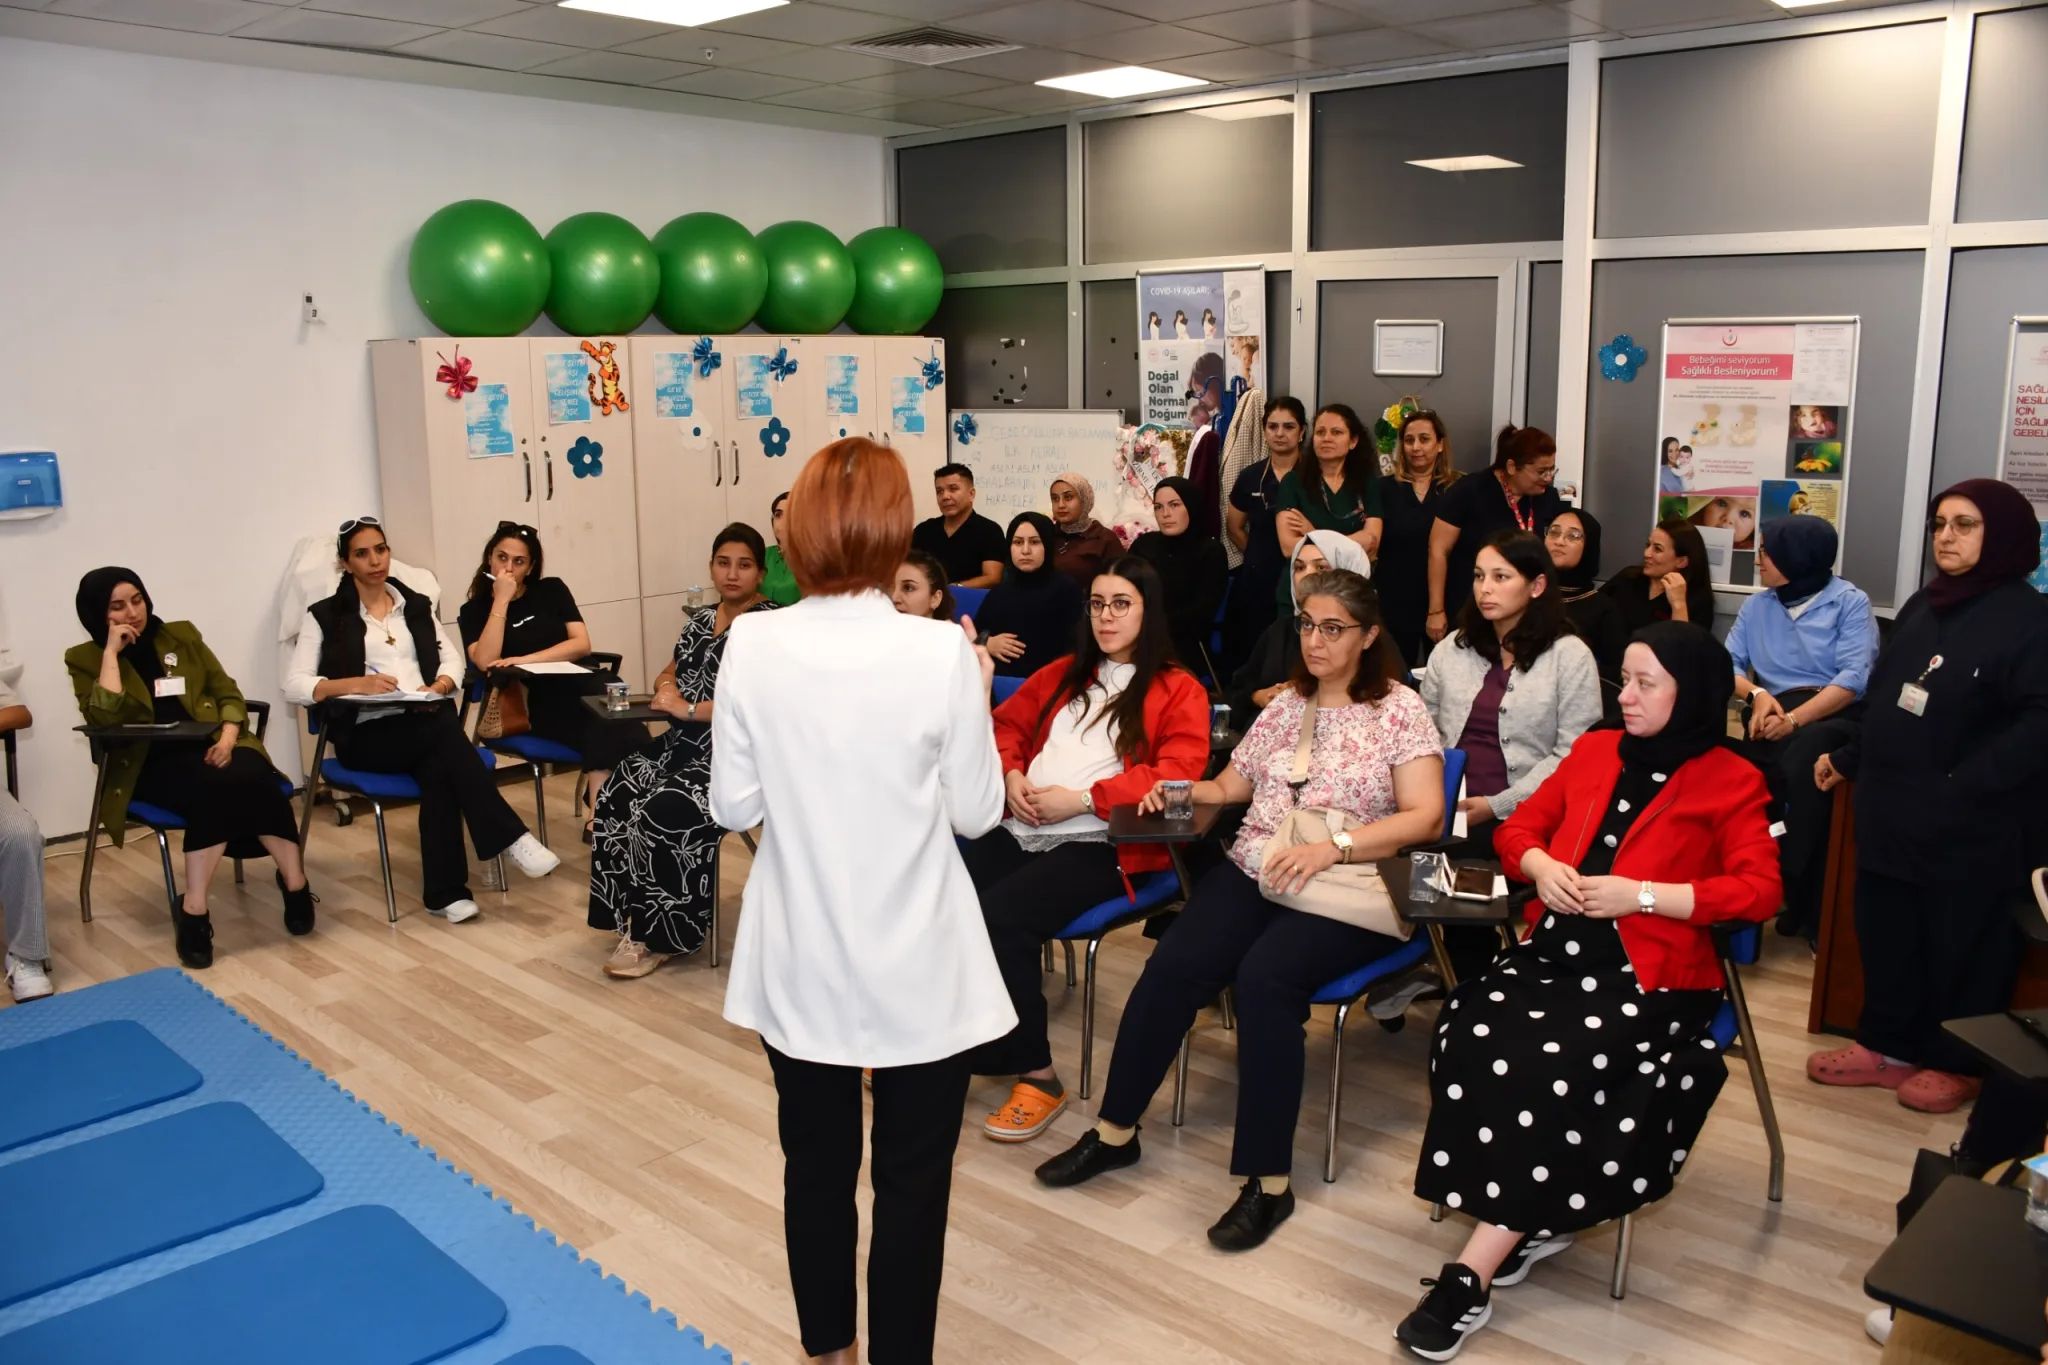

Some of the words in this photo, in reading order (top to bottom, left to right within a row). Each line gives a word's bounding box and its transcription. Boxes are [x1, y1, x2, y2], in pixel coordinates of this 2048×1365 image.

[1150, 287, 1181, 297] COVID-19
[1689, 355, 1726, 366] Bebeğimi
[1727, 357, 1771, 367] seviyorum
[1147, 370, 1179, 384] Doğal
[1681, 366, 1712, 377] Sağlıklı
[1713, 366, 1779, 378] Besleniyorum!
[1148, 383, 1174, 394] Olan
[1148, 396, 1189, 406] Normal
[1149, 408, 1188, 421] Doğum
[2015, 405, 2035, 416] İÇİN
[2013, 428, 2048, 438] GEBEL
